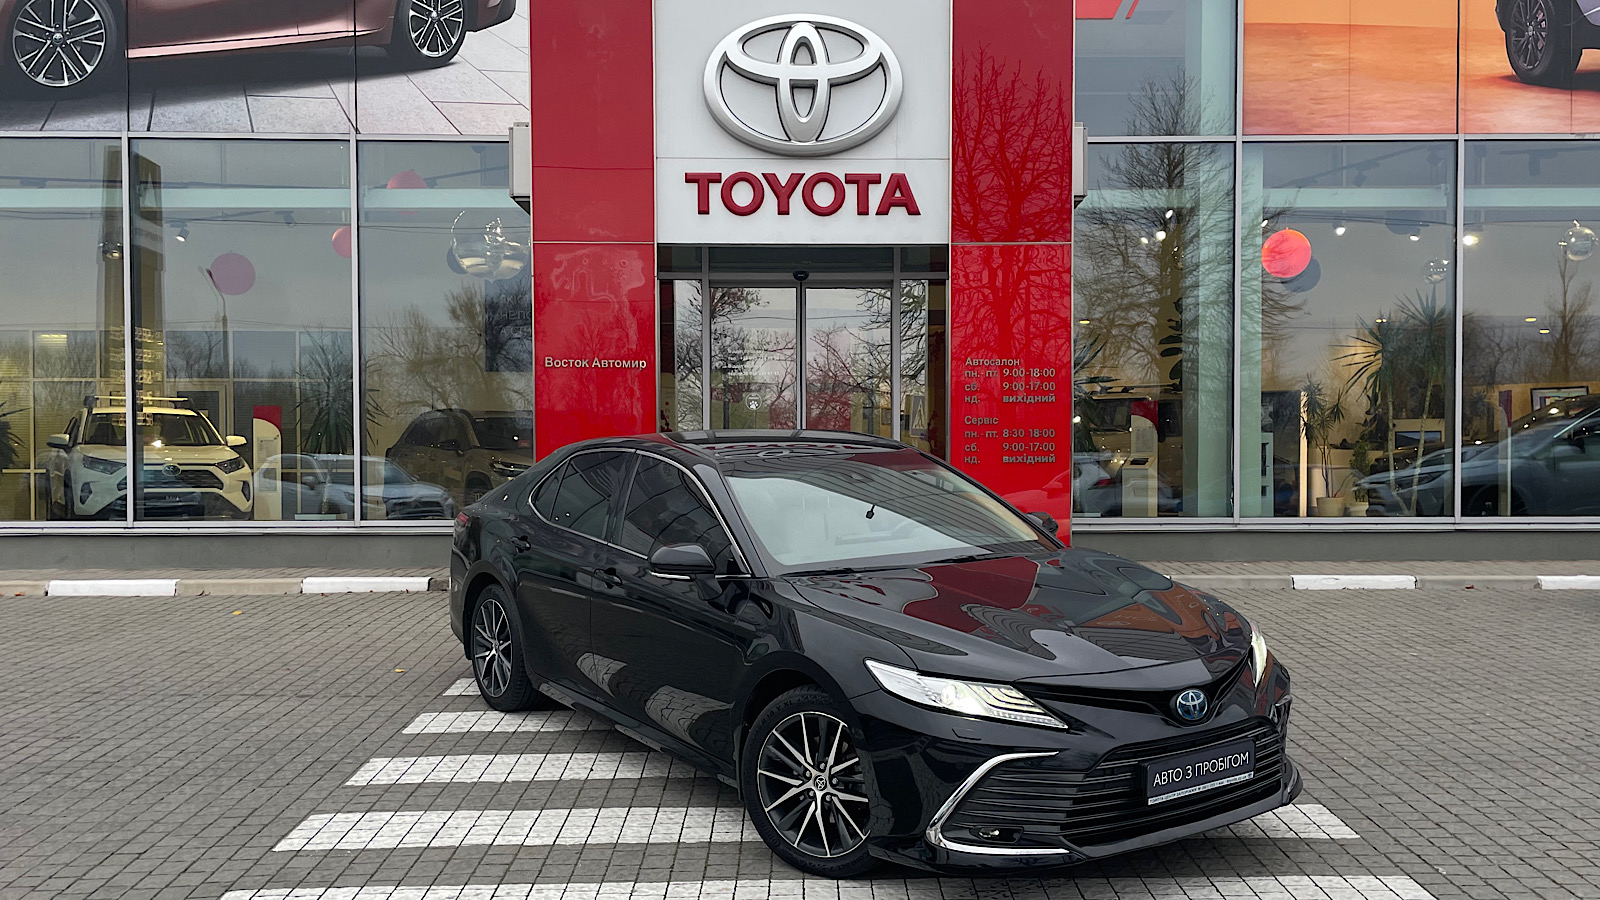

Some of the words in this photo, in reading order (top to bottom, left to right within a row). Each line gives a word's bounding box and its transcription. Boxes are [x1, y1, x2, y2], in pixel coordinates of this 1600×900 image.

[685, 171, 921, 216] TOYOTA
[545, 356, 589, 368] Восток
[592, 357, 647, 371] Автомир
[965, 357, 1020, 366] Автосалон
[964, 382, 980, 391] сб.
[964, 395, 980, 404] нд.
[1002, 392, 1056, 404] вихідний
[964, 415, 999, 426] Сервіс
[964, 442, 980, 452] сб.
[1002, 442, 1056, 452] 9:00-17:00
[964, 455, 981, 465] нд.
[1002, 453, 1056, 465] вихідний
[1153, 768, 1183, 787] АВТО
[1195, 751, 1249, 777] ПРОБІГОМ
